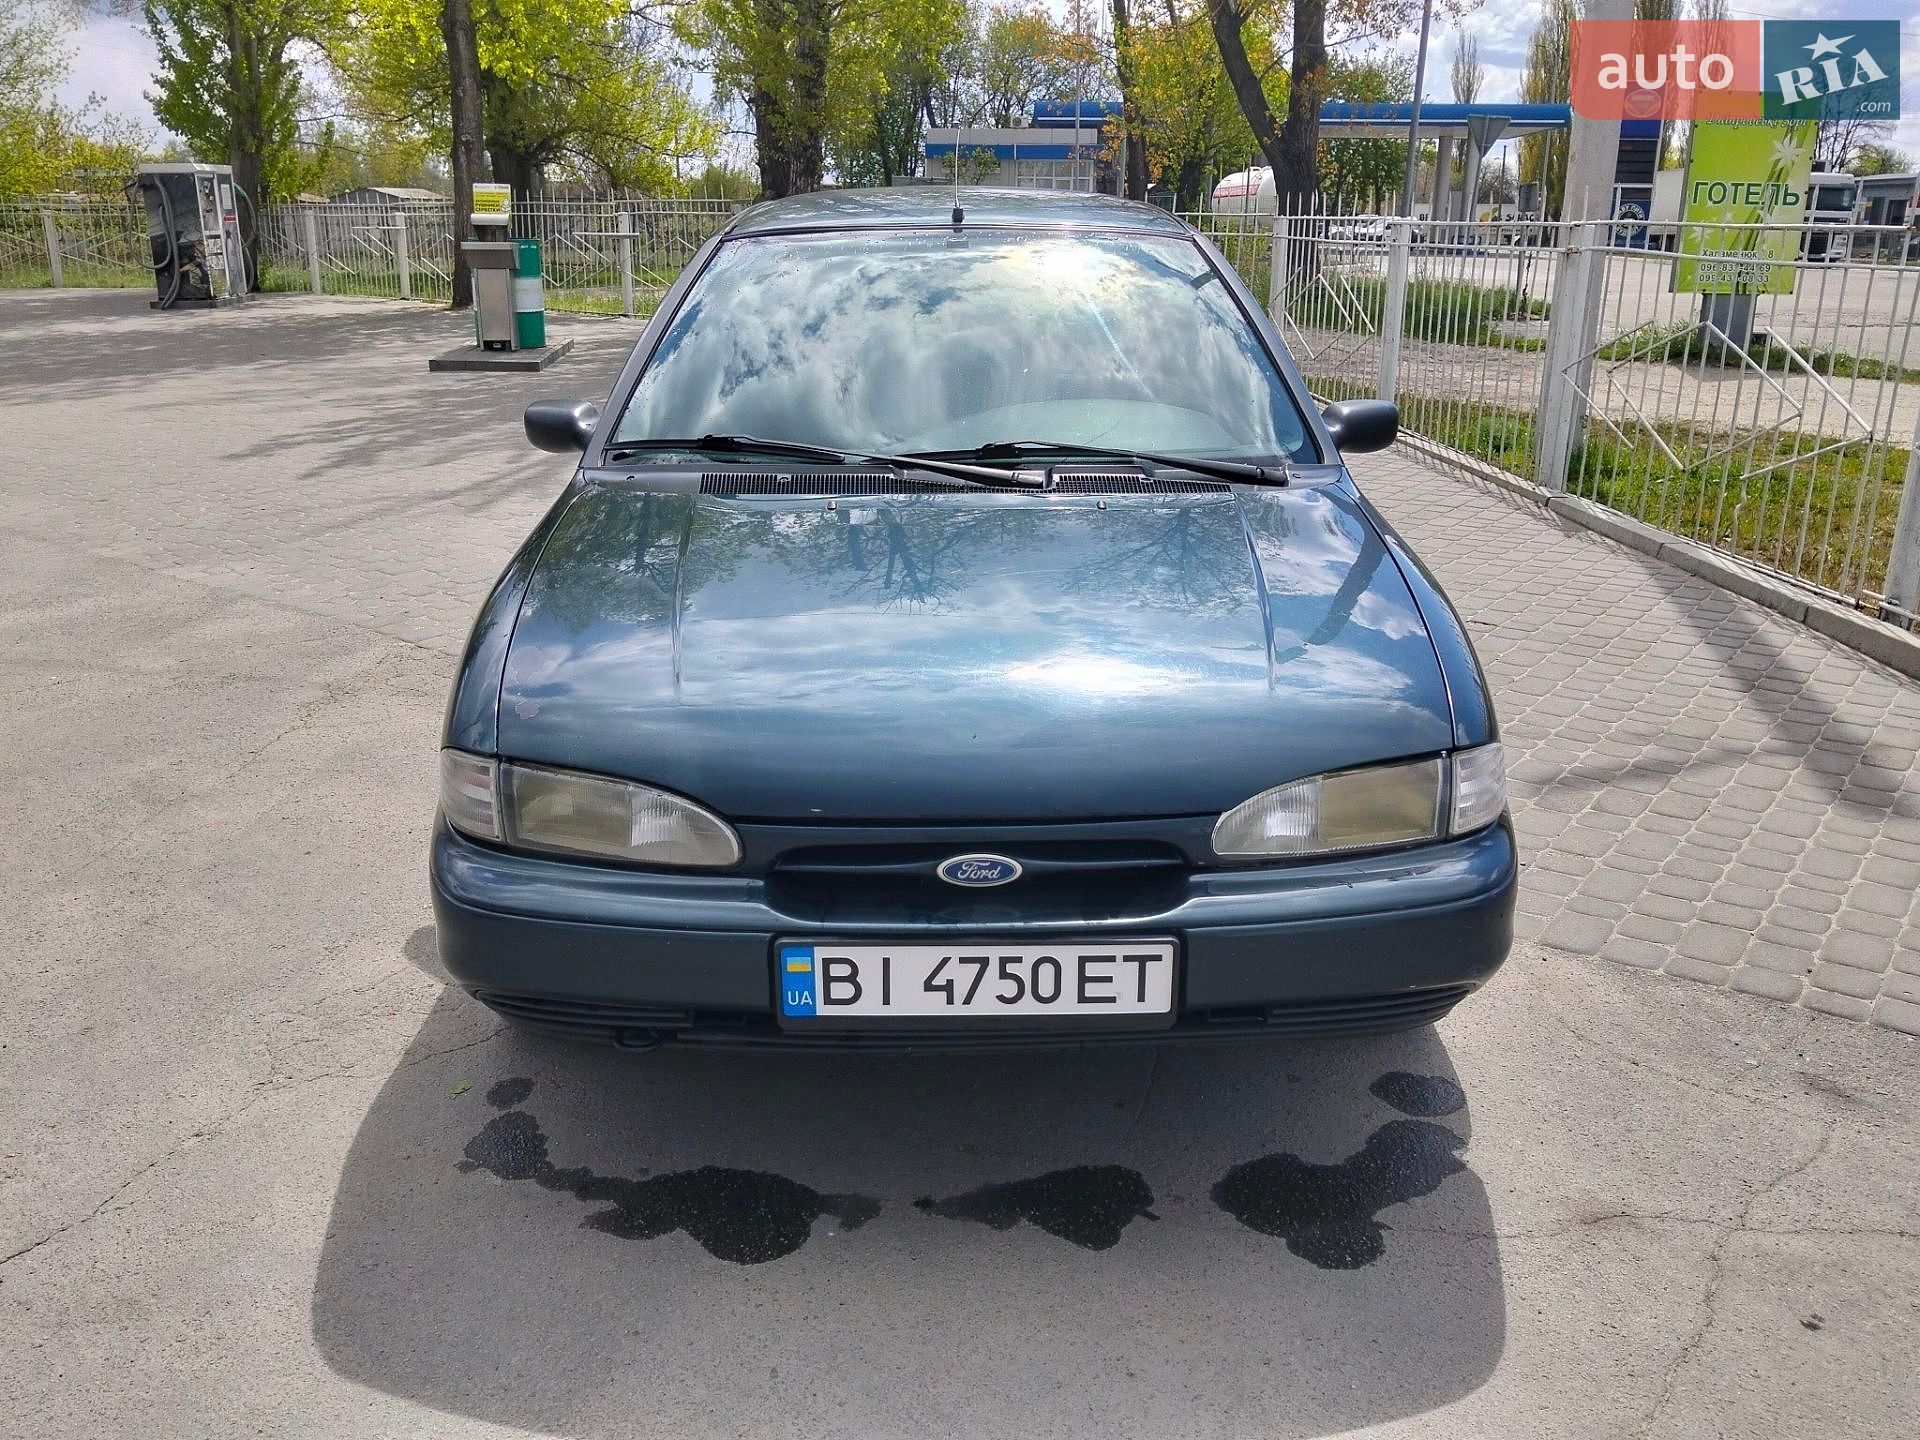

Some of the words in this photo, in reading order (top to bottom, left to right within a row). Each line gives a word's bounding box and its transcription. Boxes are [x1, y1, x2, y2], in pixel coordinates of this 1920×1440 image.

[1693, 181, 1800, 206] ГОТЕЛЬ
[957, 861, 1001, 879] Ford
[821, 956, 891, 1006] BI
[923, 956, 1062, 1006] 4750
[1077, 954, 1163, 1005] ET
[787, 991, 813, 1006] UA
